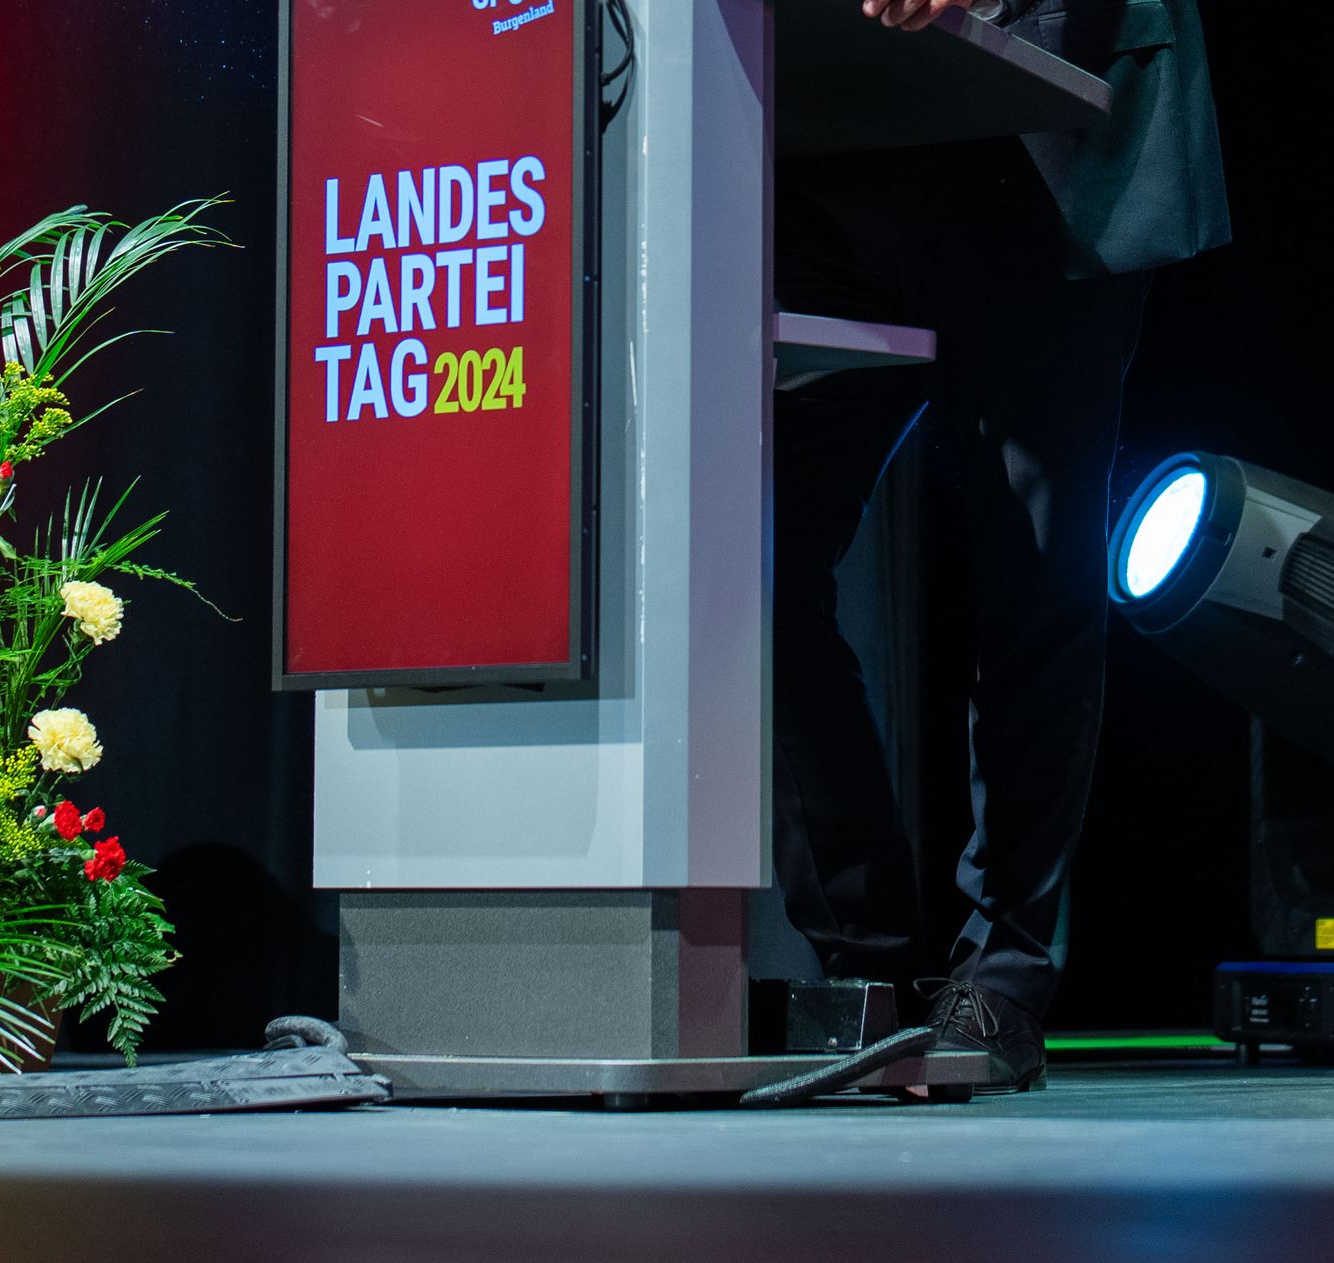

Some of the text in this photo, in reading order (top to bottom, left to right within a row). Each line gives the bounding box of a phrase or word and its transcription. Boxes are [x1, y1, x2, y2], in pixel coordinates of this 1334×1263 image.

[492, 0, 555, 35] Burgenland
[325, 156, 546, 255] LANDES
[326, 243, 524, 338] PARTEI
[314, 338, 527, 422] TAG 2024
